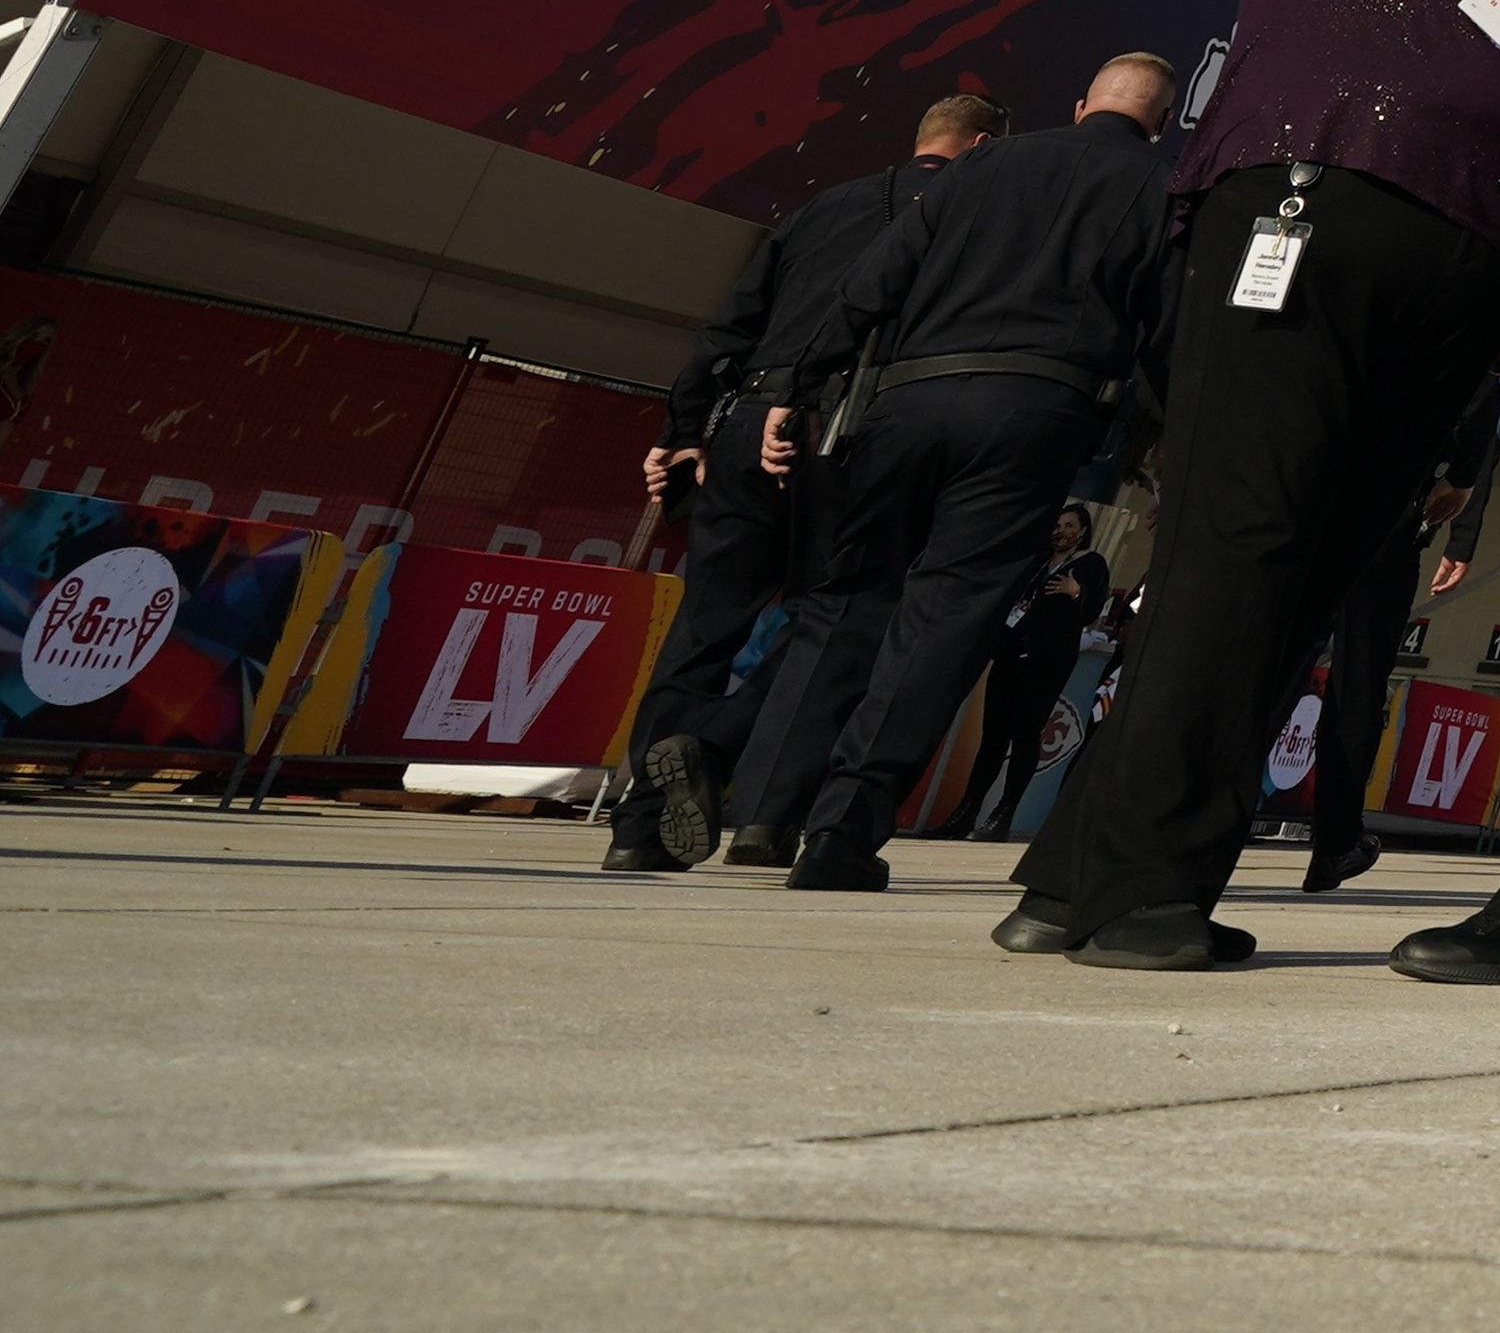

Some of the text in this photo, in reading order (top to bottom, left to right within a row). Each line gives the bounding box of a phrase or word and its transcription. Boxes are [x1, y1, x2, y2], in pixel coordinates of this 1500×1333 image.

[465, 581, 614, 617] SUPER BOWL
[402, 607, 607, 745] LV
[1432, 704, 1490, 730] SUPER BOWL
[1407, 721, 1487, 811] LV
